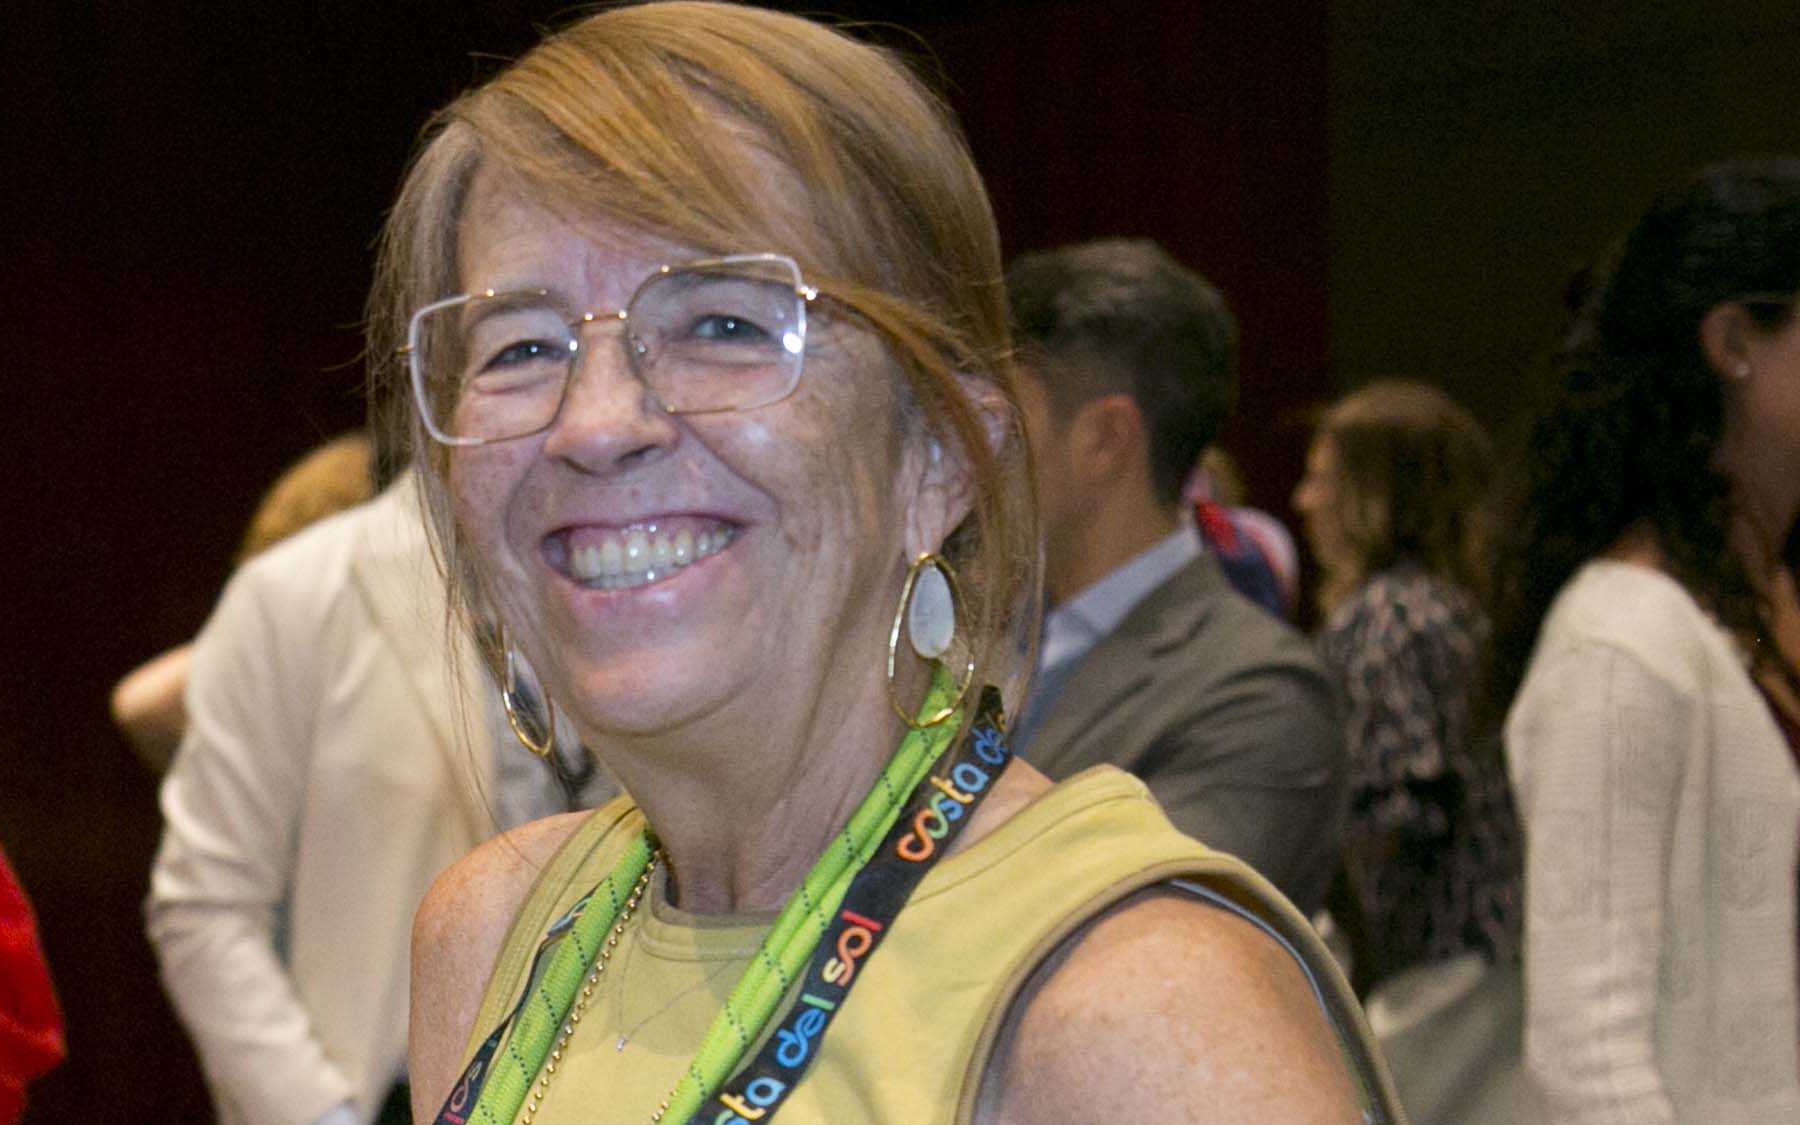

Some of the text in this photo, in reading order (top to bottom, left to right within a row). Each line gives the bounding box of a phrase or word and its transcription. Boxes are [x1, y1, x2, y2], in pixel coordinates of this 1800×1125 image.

[896, 762, 990, 862] costa
[775, 993, 835, 1069] del
[822, 910, 883, 987] sol
